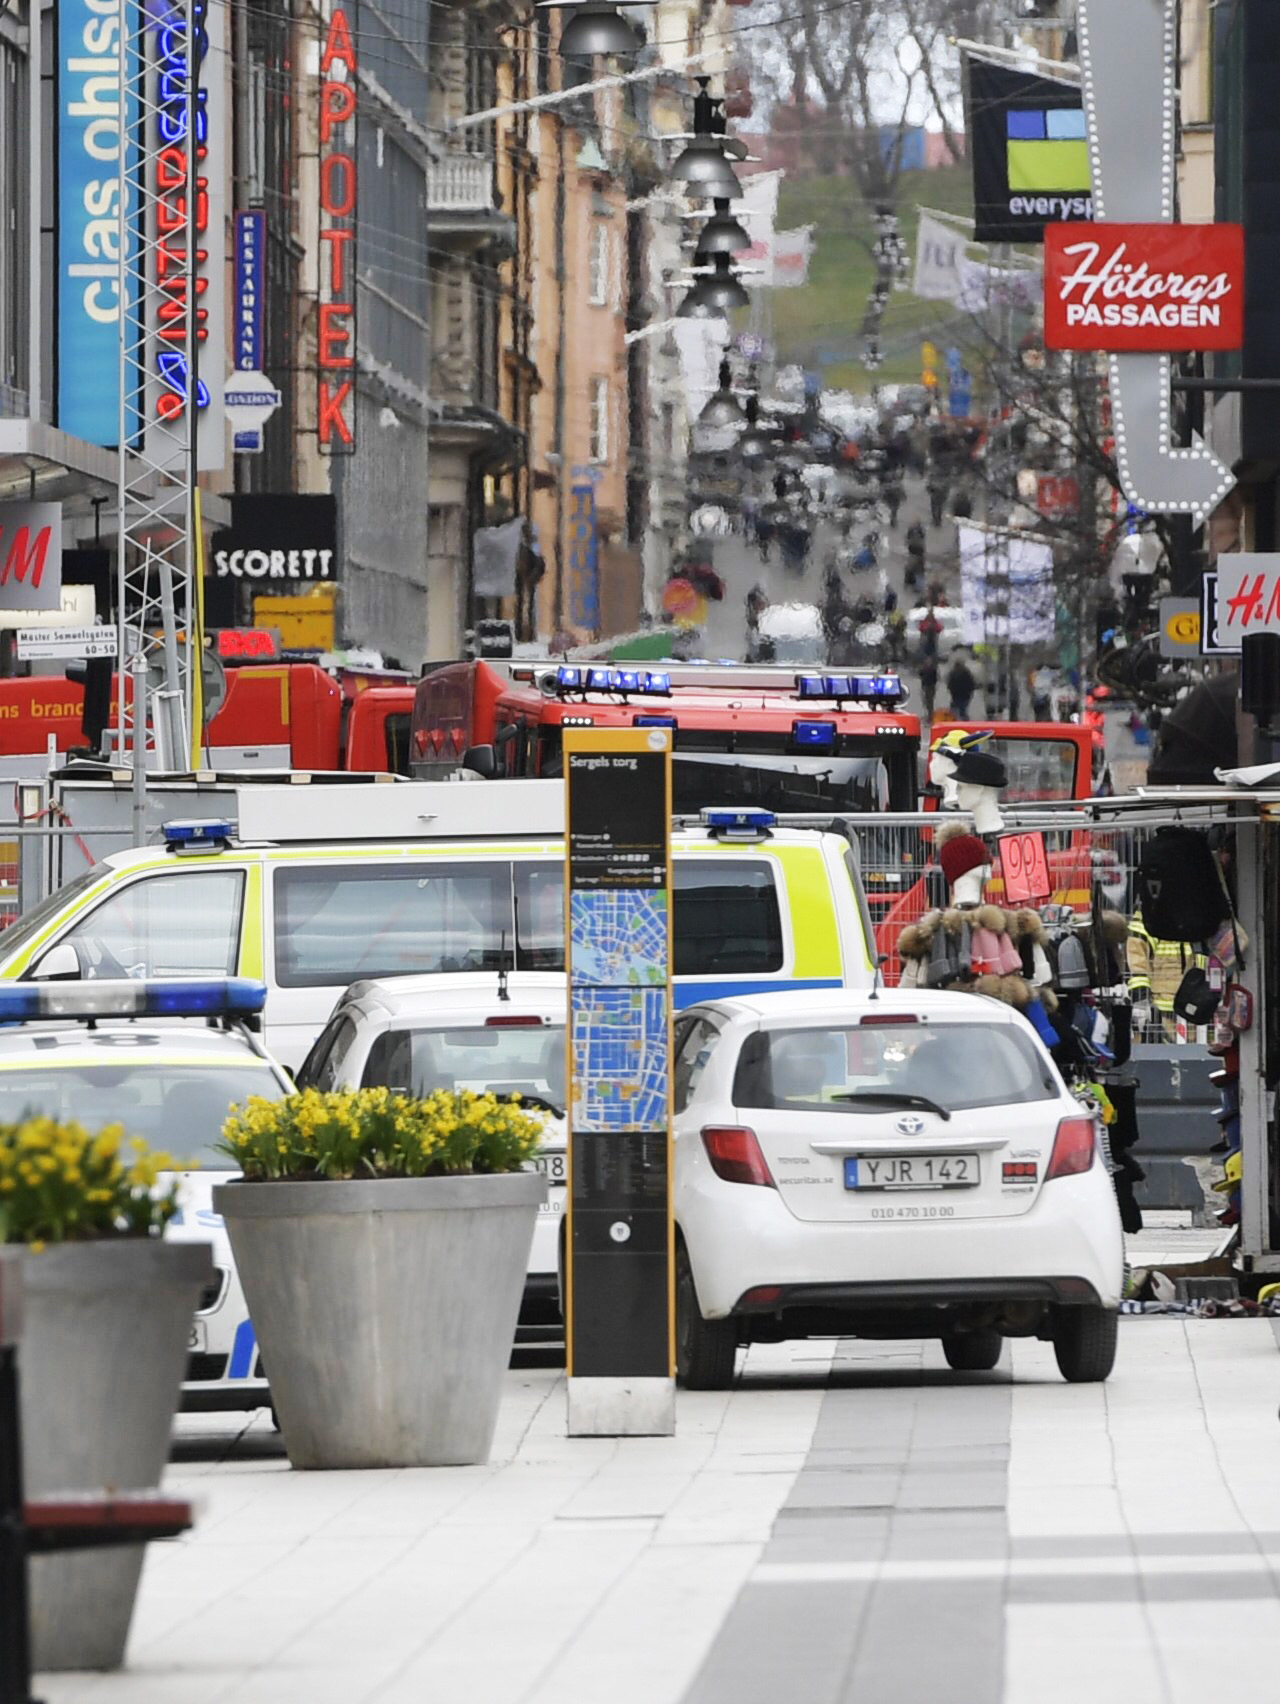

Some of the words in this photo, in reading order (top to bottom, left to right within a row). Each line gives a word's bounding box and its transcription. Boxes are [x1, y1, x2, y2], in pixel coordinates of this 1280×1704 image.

[156, 0, 209, 340] INTERSPO
[319, 9, 358, 444] APOTEK
[68, 177, 128, 323] clas
[240, 216, 256, 371] RESTAURANG
[1060, 242, 1232, 305] Hötorgs
[1066, 303, 1221, 326] PASSAGEN
[214, 549, 332, 578] SCORETT
[570, 755, 610, 771] Sergels
[613, 756, 638, 771] torg
[867, 1160, 913, 1182] YJR
[926, 1158, 969, 1181] 142
[871, 1208, 894, 1219] 010
[897, 1208, 919, 1218] 470
[922, 1207, 937, 1218] 10
[939, 1206, 955, 1217] 00
